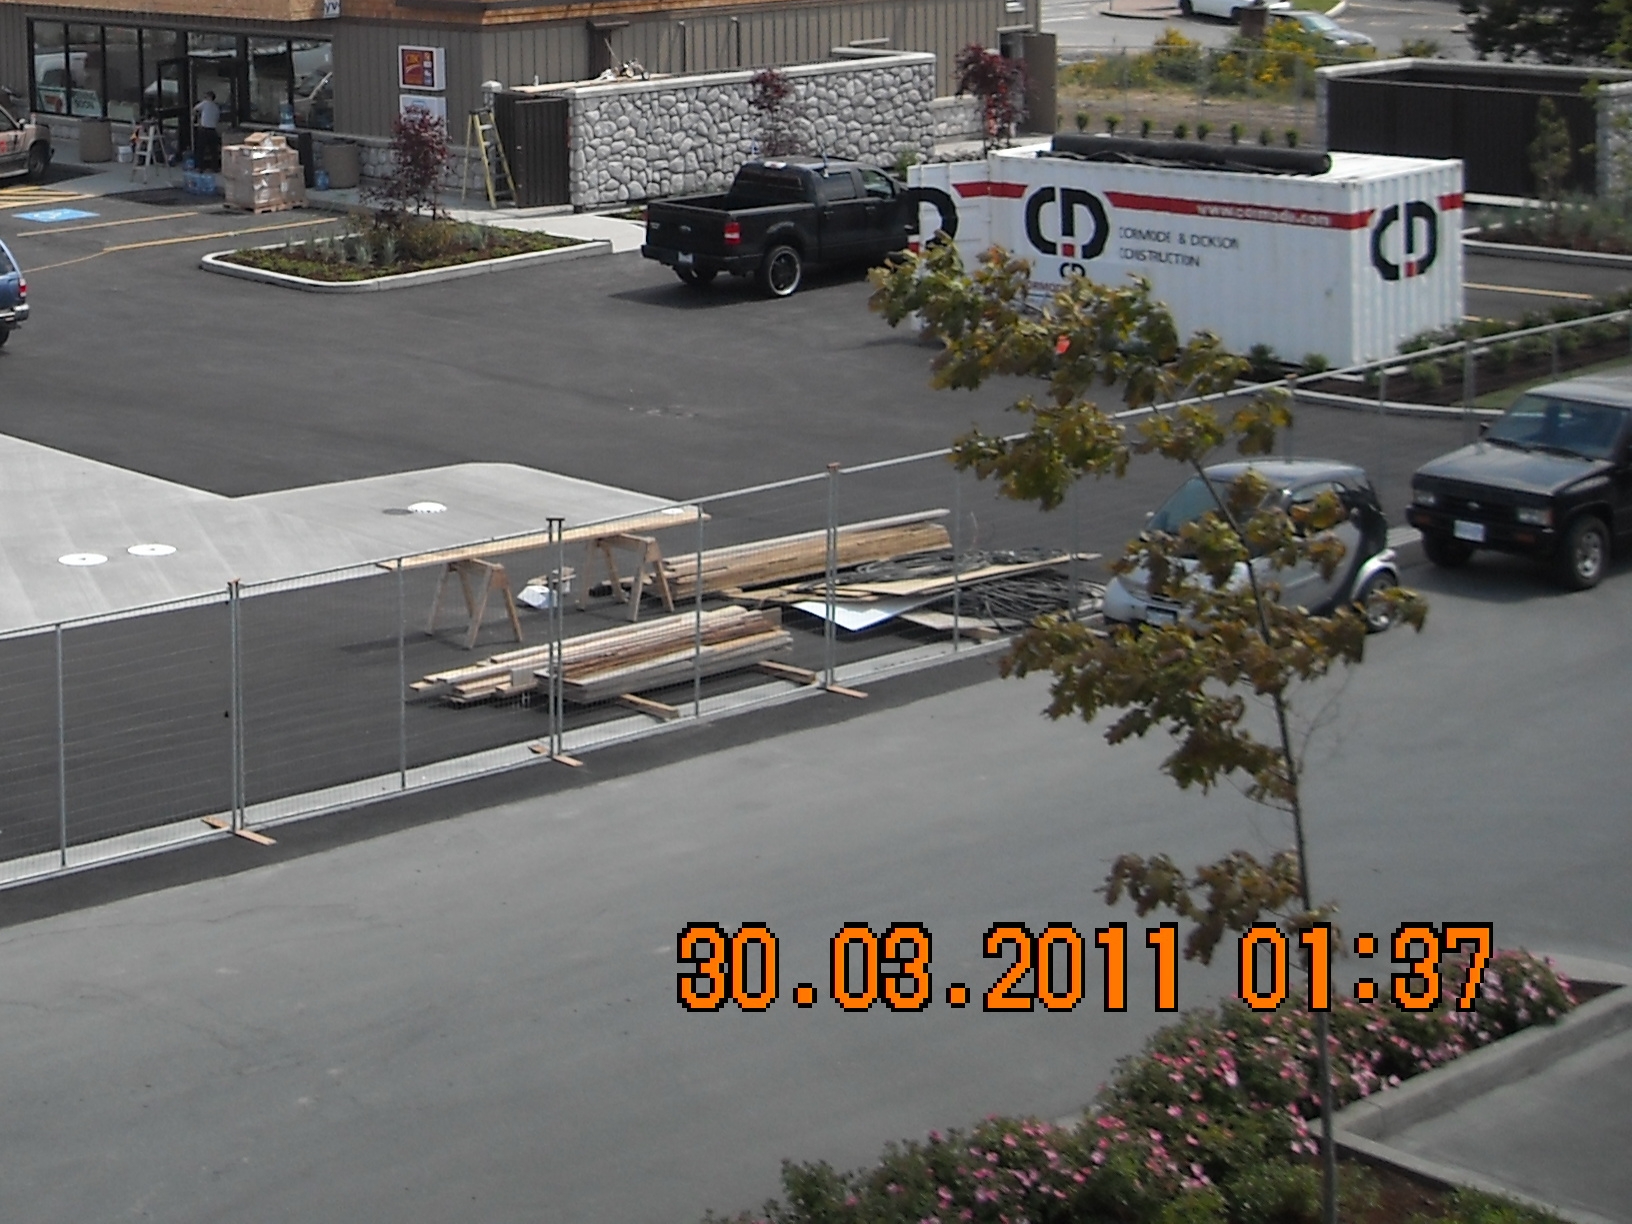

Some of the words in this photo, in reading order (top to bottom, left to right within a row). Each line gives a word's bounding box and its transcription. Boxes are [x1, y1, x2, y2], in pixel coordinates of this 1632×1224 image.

[1119, 226, 1171, 243] CORMODE
[1179, 232, 1186, 245] &
[1119, 246, 1200, 267] CONSTRUCTION
